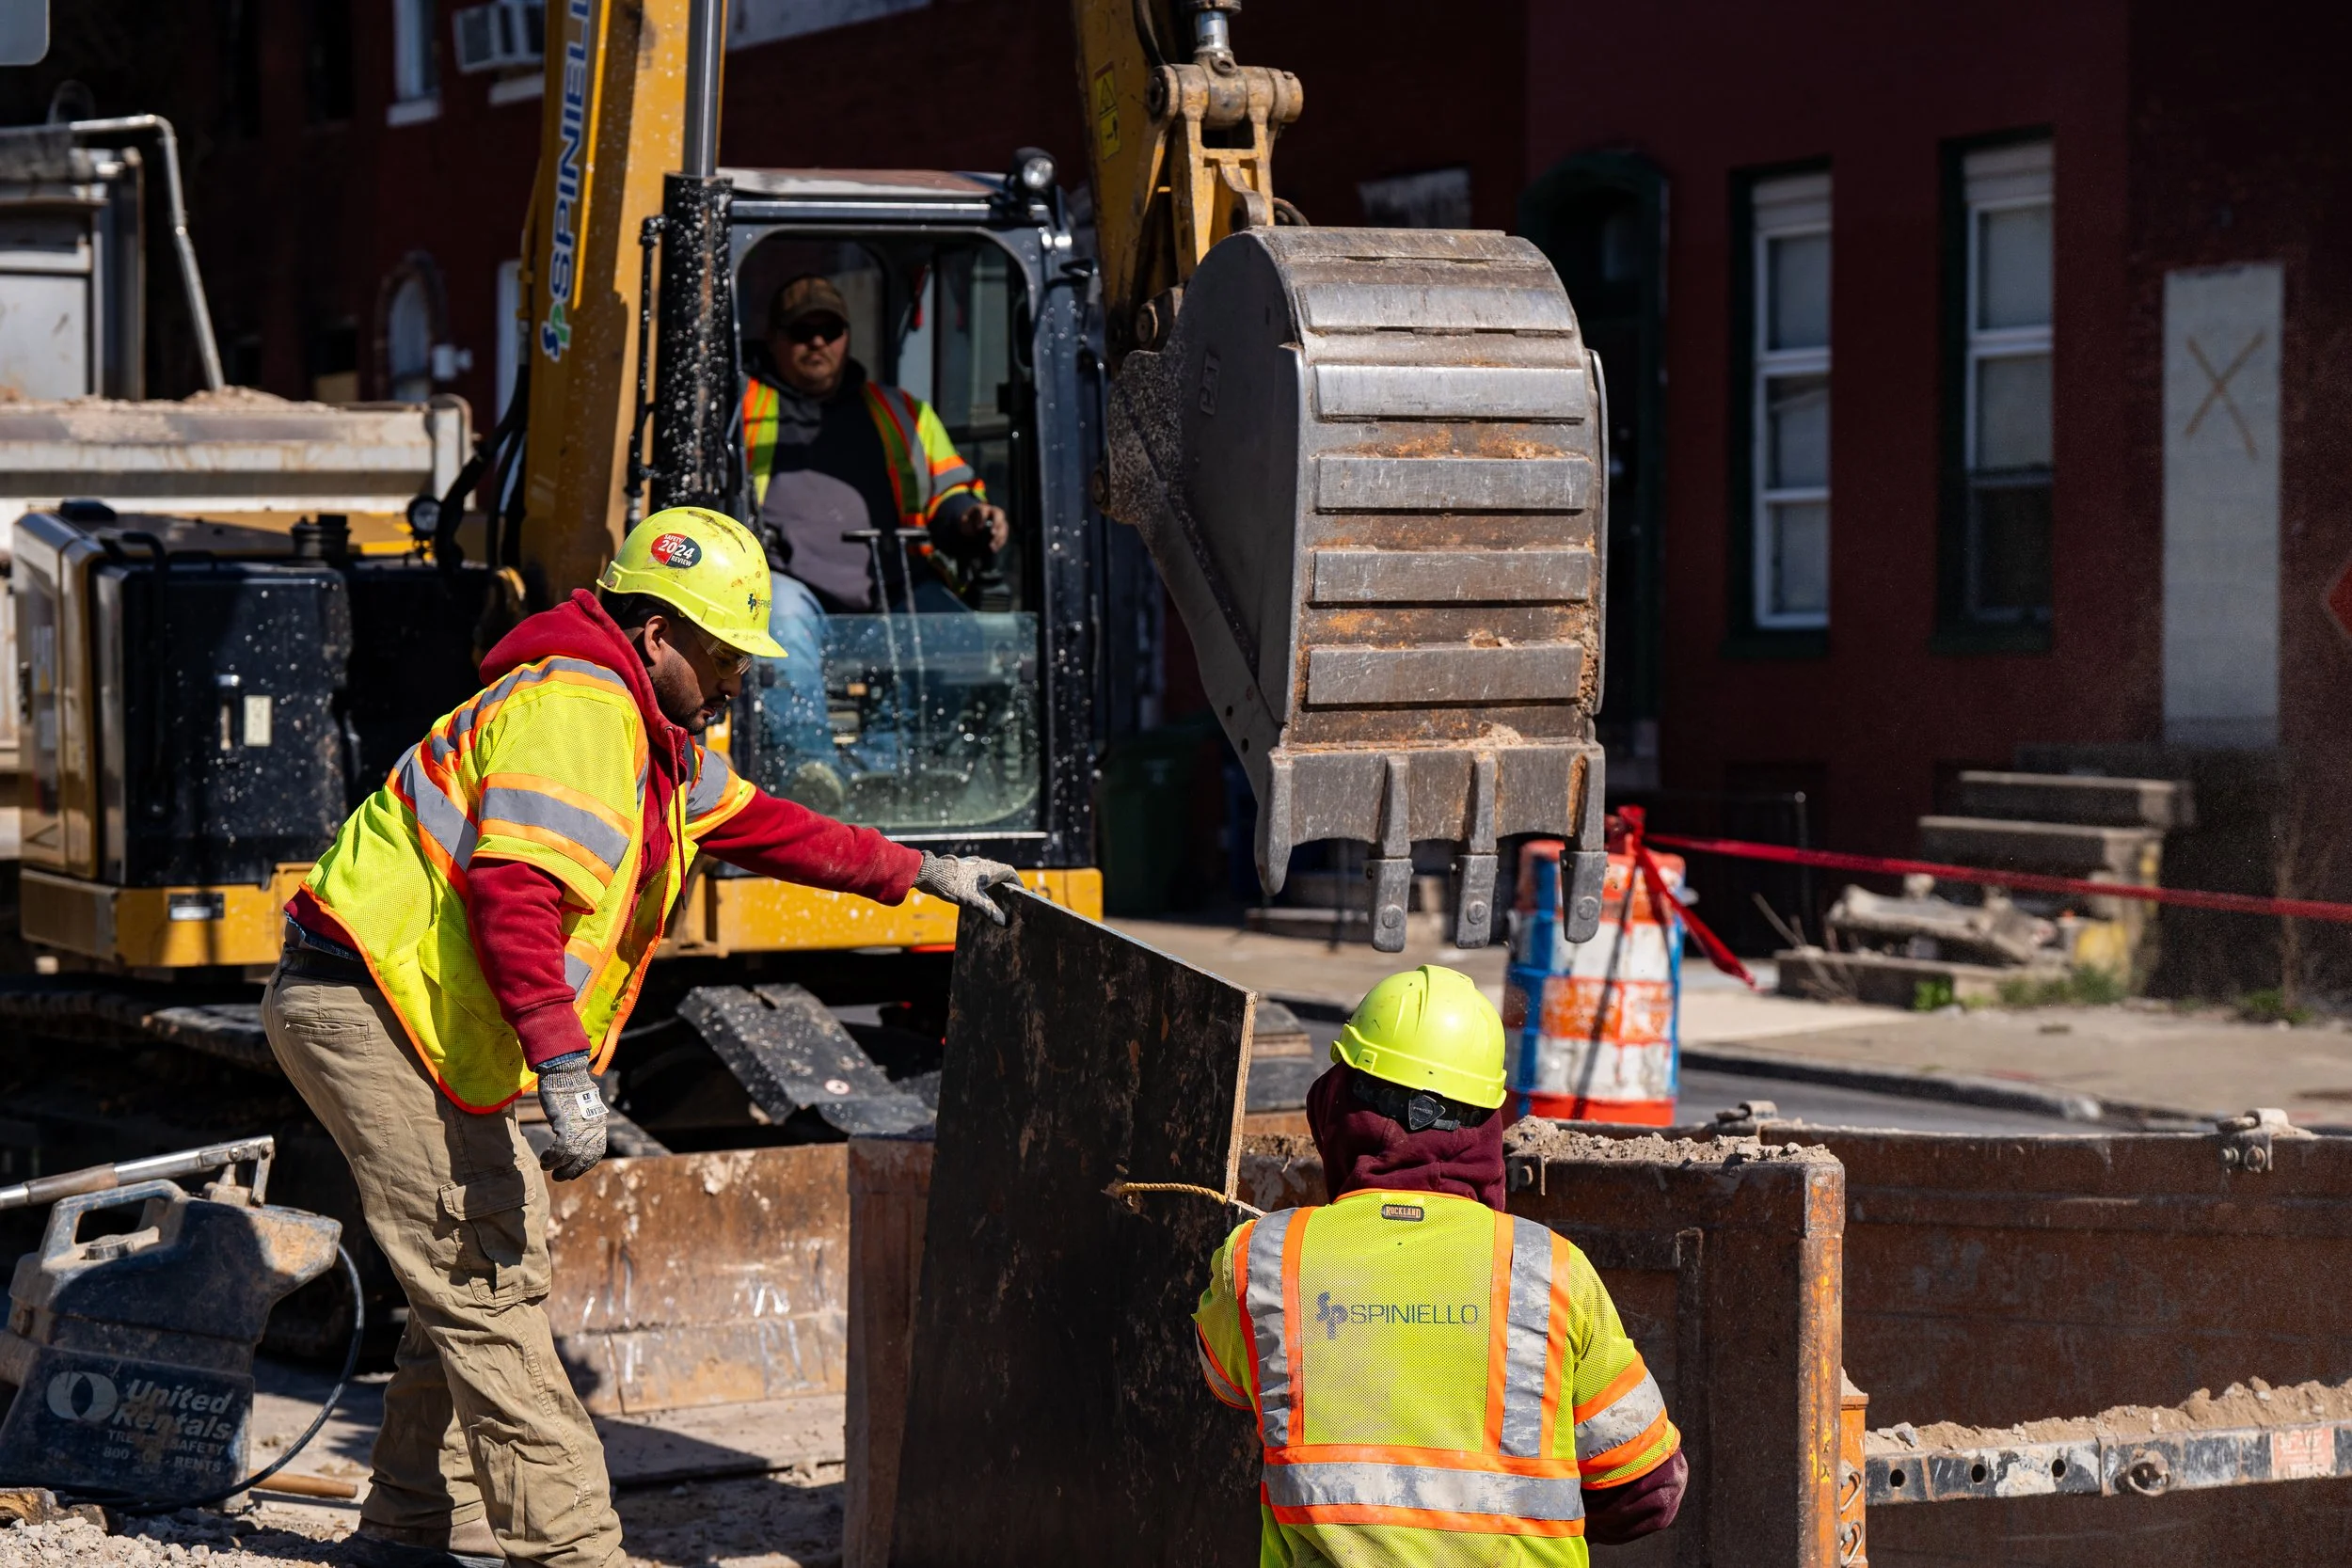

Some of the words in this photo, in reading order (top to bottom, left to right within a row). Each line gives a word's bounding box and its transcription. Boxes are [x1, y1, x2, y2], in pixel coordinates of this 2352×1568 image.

[663, 534, 684, 544] SAFETY
[670, 555, 692, 566] REVIEW
[1385, 1206, 1422, 1219] ROCKLAND
[1349, 1303, 1479, 1325] SPINIELLO
[126, 1379, 234, 1415] United
[112, 1402, 233, 1441] Rentals
[102, 1446, 130, 1461] 800
